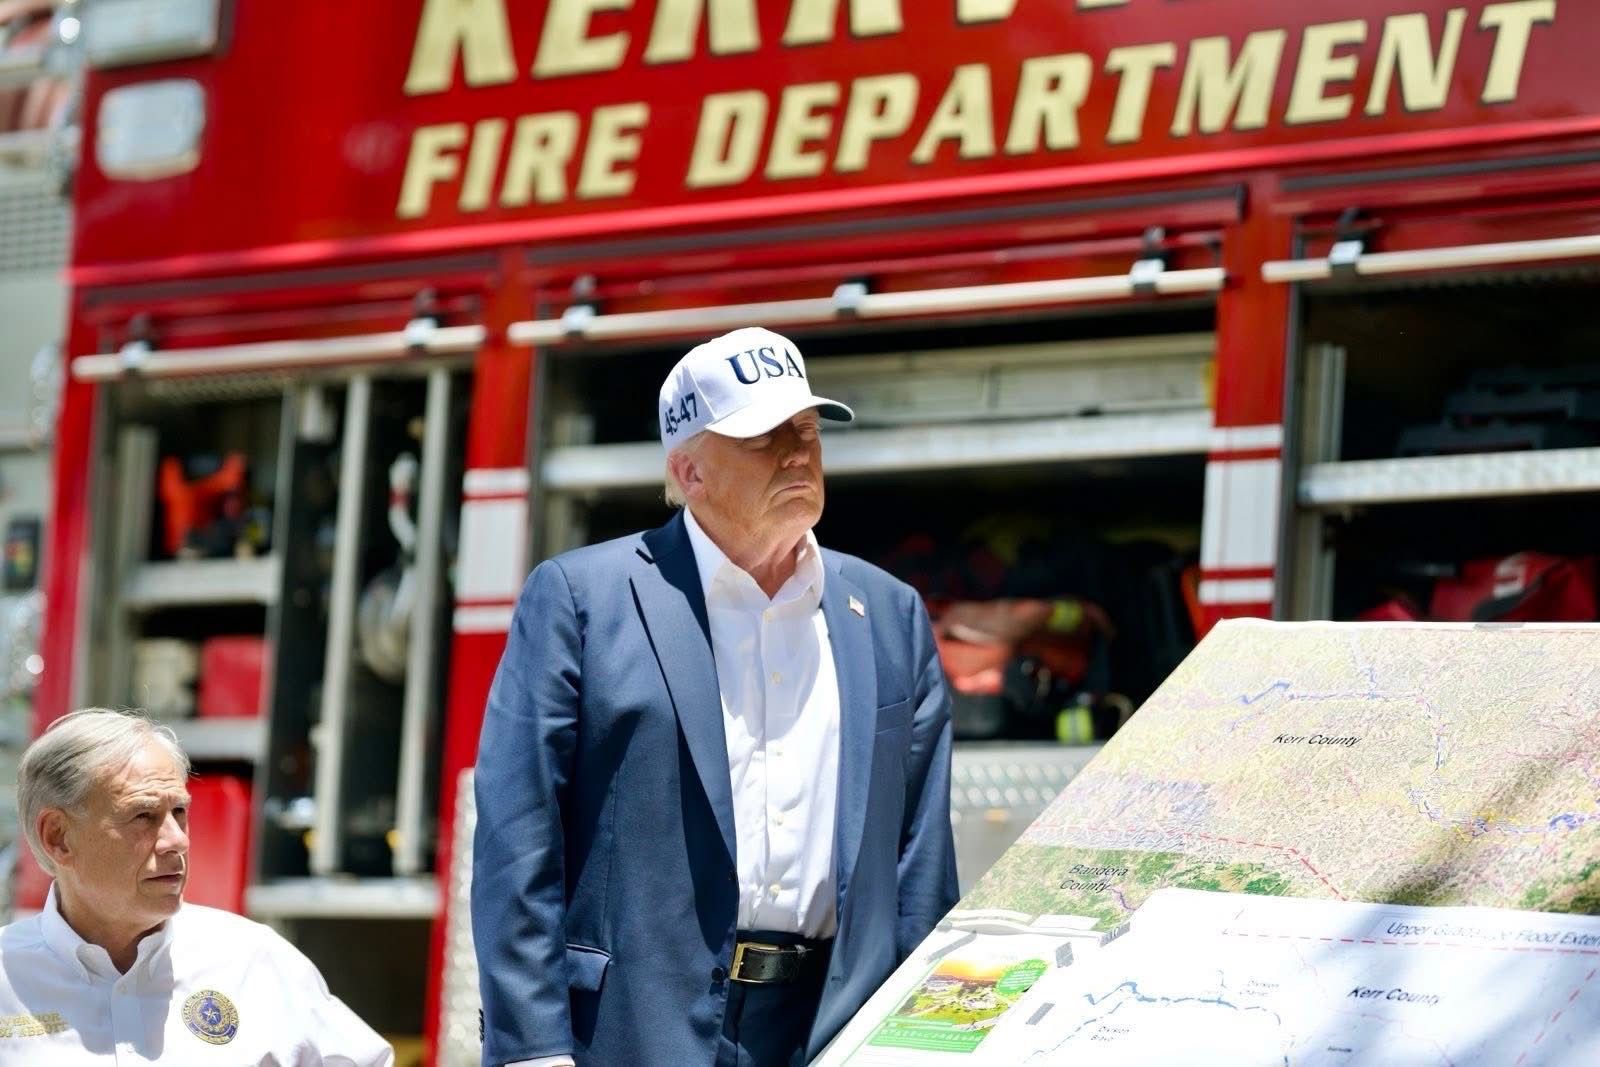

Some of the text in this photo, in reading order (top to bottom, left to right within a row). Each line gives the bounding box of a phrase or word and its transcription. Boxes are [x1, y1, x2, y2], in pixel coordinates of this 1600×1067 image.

[397, 0, 1556, 219] FIRE DEPARTMENT
[725, 347, 805, 385] USA
[665, 392, 698, 436] 45-47
[1272, 733, 1363, 748] Kerr County
[1068, 864, 1129, 876] Bandera
[1060, 879, 1111, 894] County
[1386, 921, 1431, 937] Upper
[1347, 986, 1385, 999] Kerr
